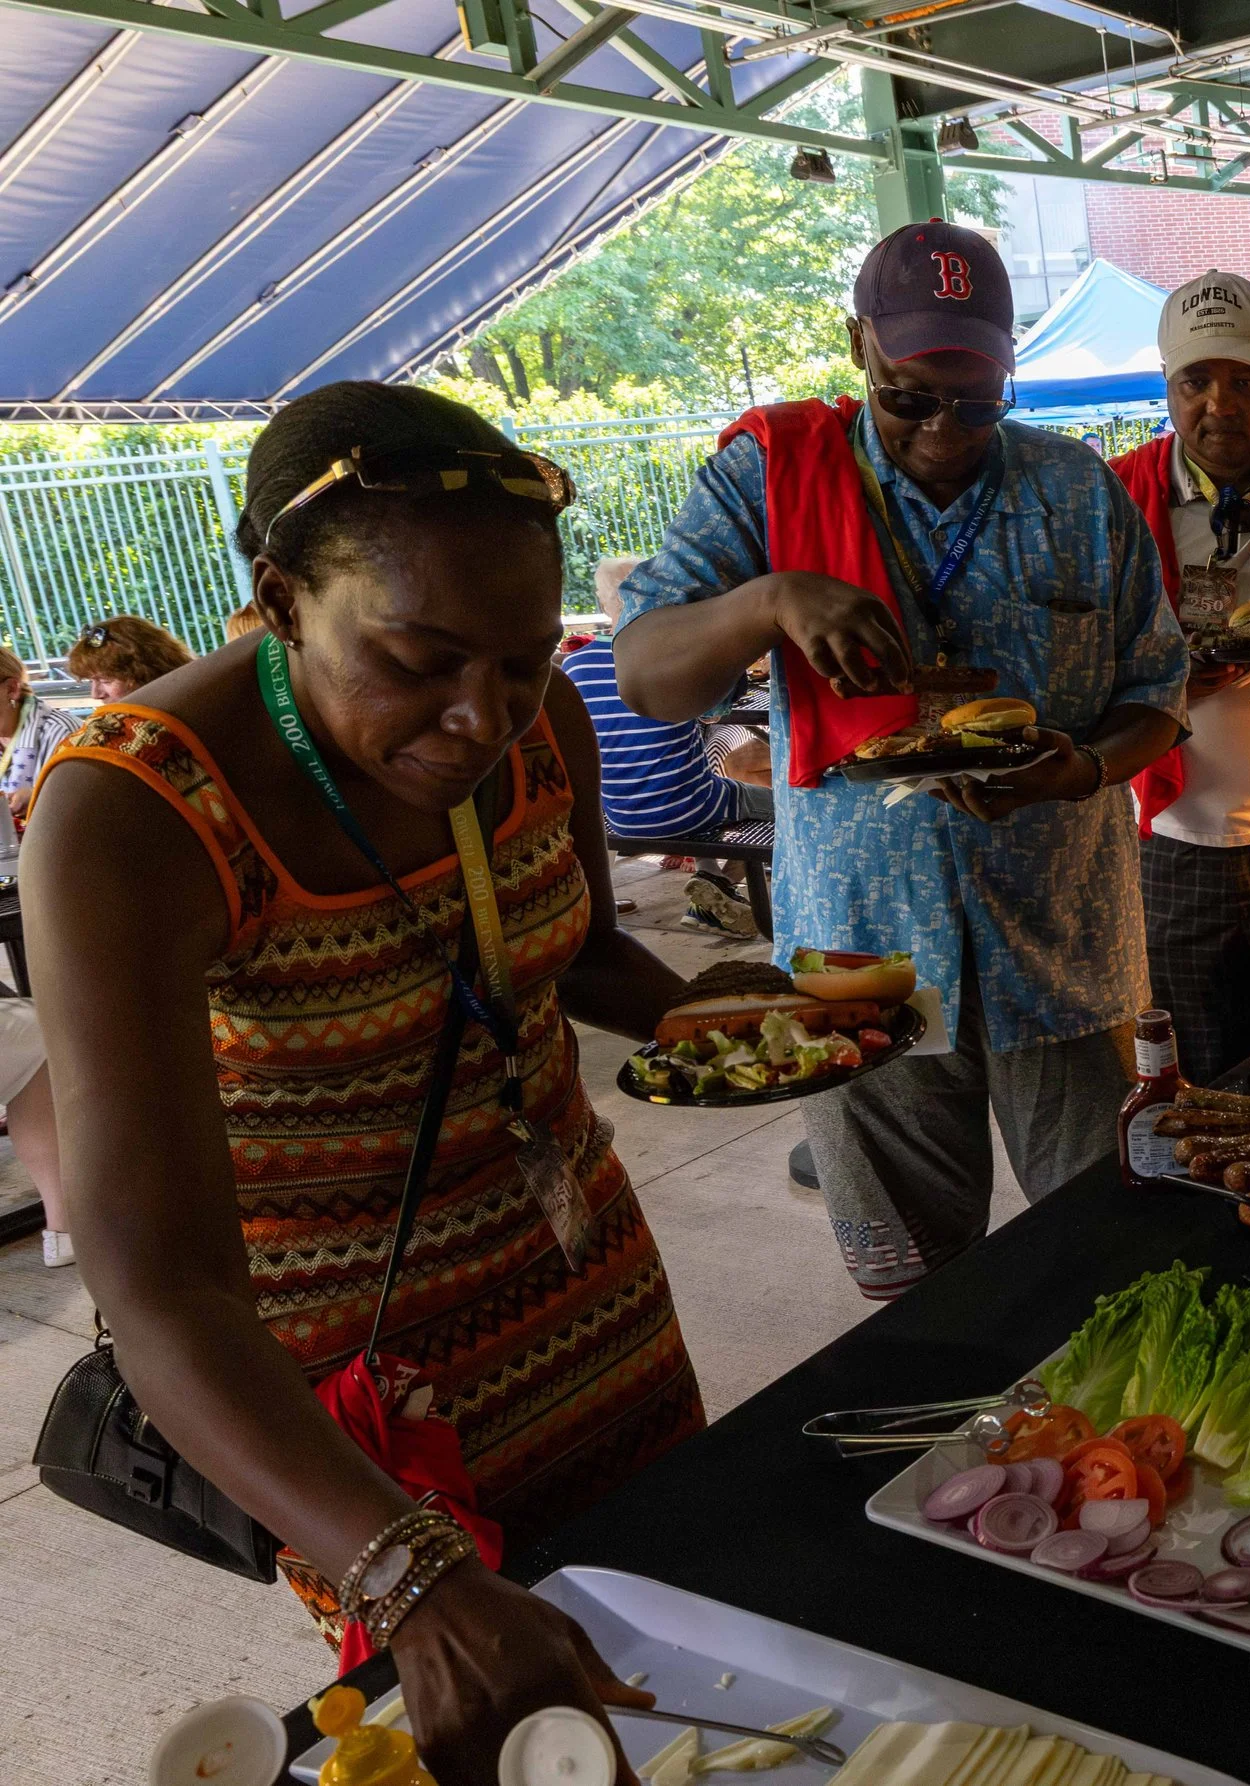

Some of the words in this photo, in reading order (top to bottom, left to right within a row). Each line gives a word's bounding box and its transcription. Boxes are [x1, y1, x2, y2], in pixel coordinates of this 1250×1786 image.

[931, 251, 973, 300] B
[1182, 286, 1242, 316] LOWELL
[1190, 322, 1236, 333] MASSACHUSETTS
[935, 563, 956, 591] LOWELL
[950, 538, 969, 560] 200
[964, 487, 996, 538] BICENTENNIAL
[279, 713, 311, 753] 200
[454, 807, 477, 858] LOWELL
[467, 865, 490, 901] 200
[476, 906, 503, 1000] BICENTENNIAL
